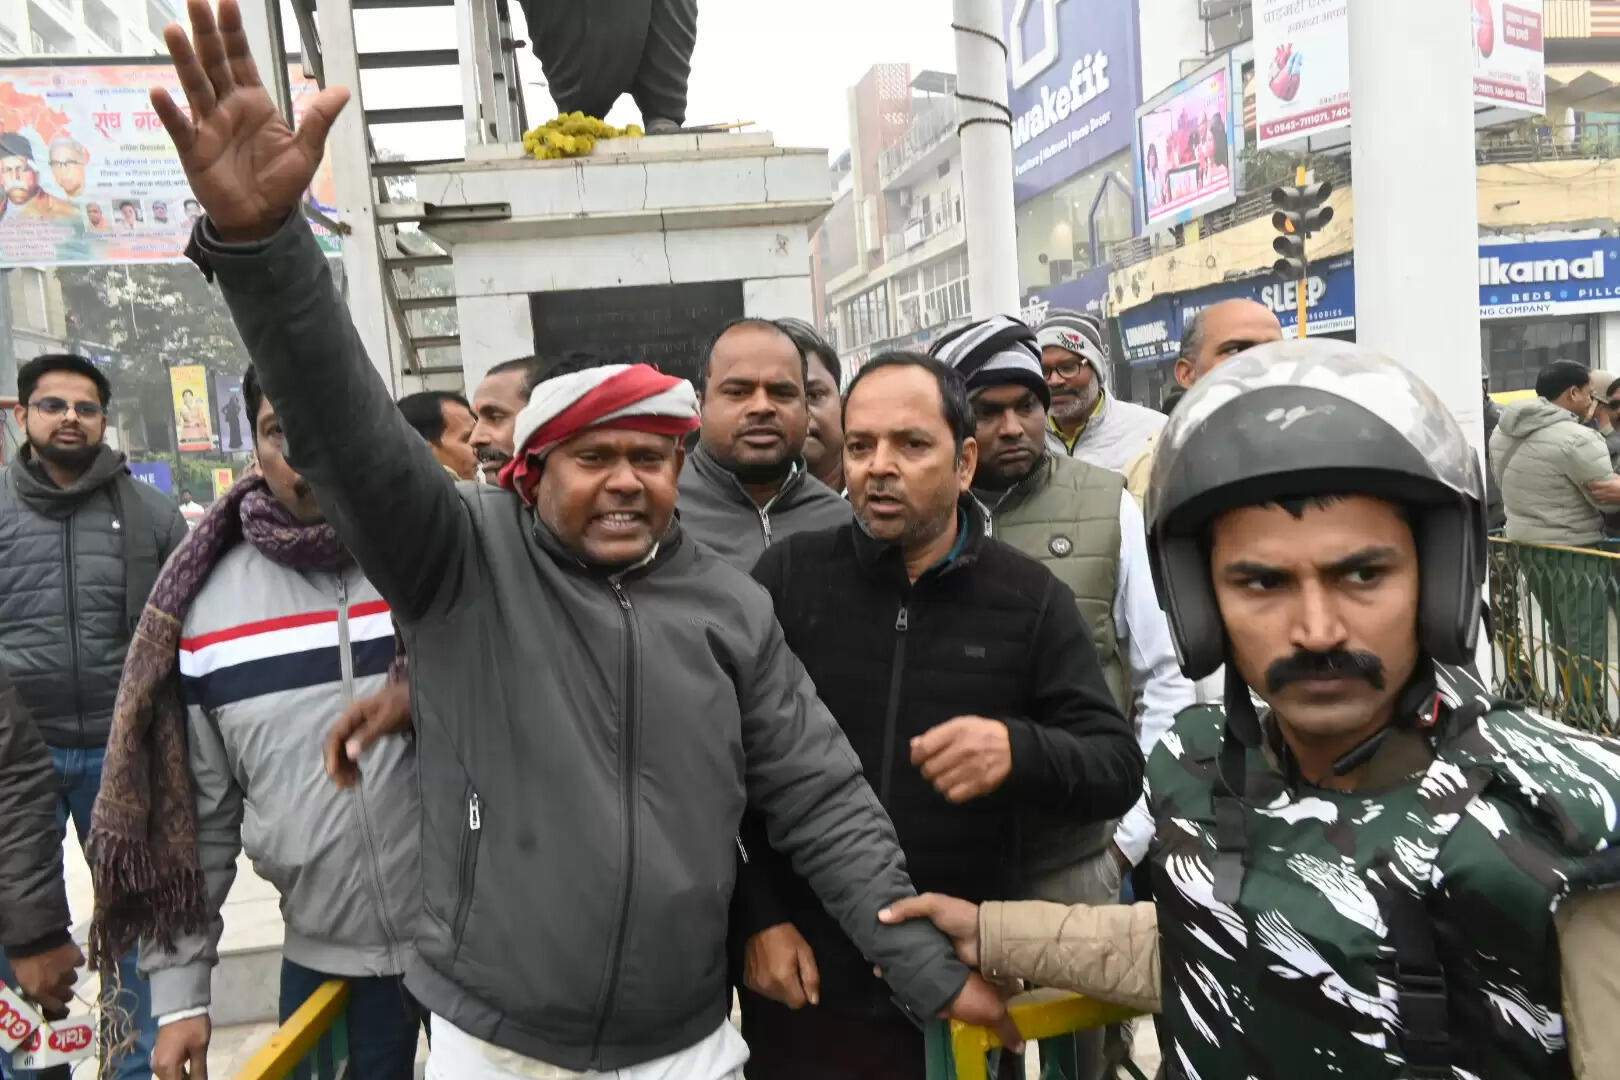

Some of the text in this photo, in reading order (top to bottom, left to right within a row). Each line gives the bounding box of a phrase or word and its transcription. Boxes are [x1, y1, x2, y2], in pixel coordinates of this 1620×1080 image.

[1012, 49, 1110, 149] wakefit
[1262, 275, 1326, 312] SLEP
[1511, 291, 1552, 303] BEDS
[1498, 303, 1551, 315] COMPANY
[55, 1028, 87, 1049] Tak
